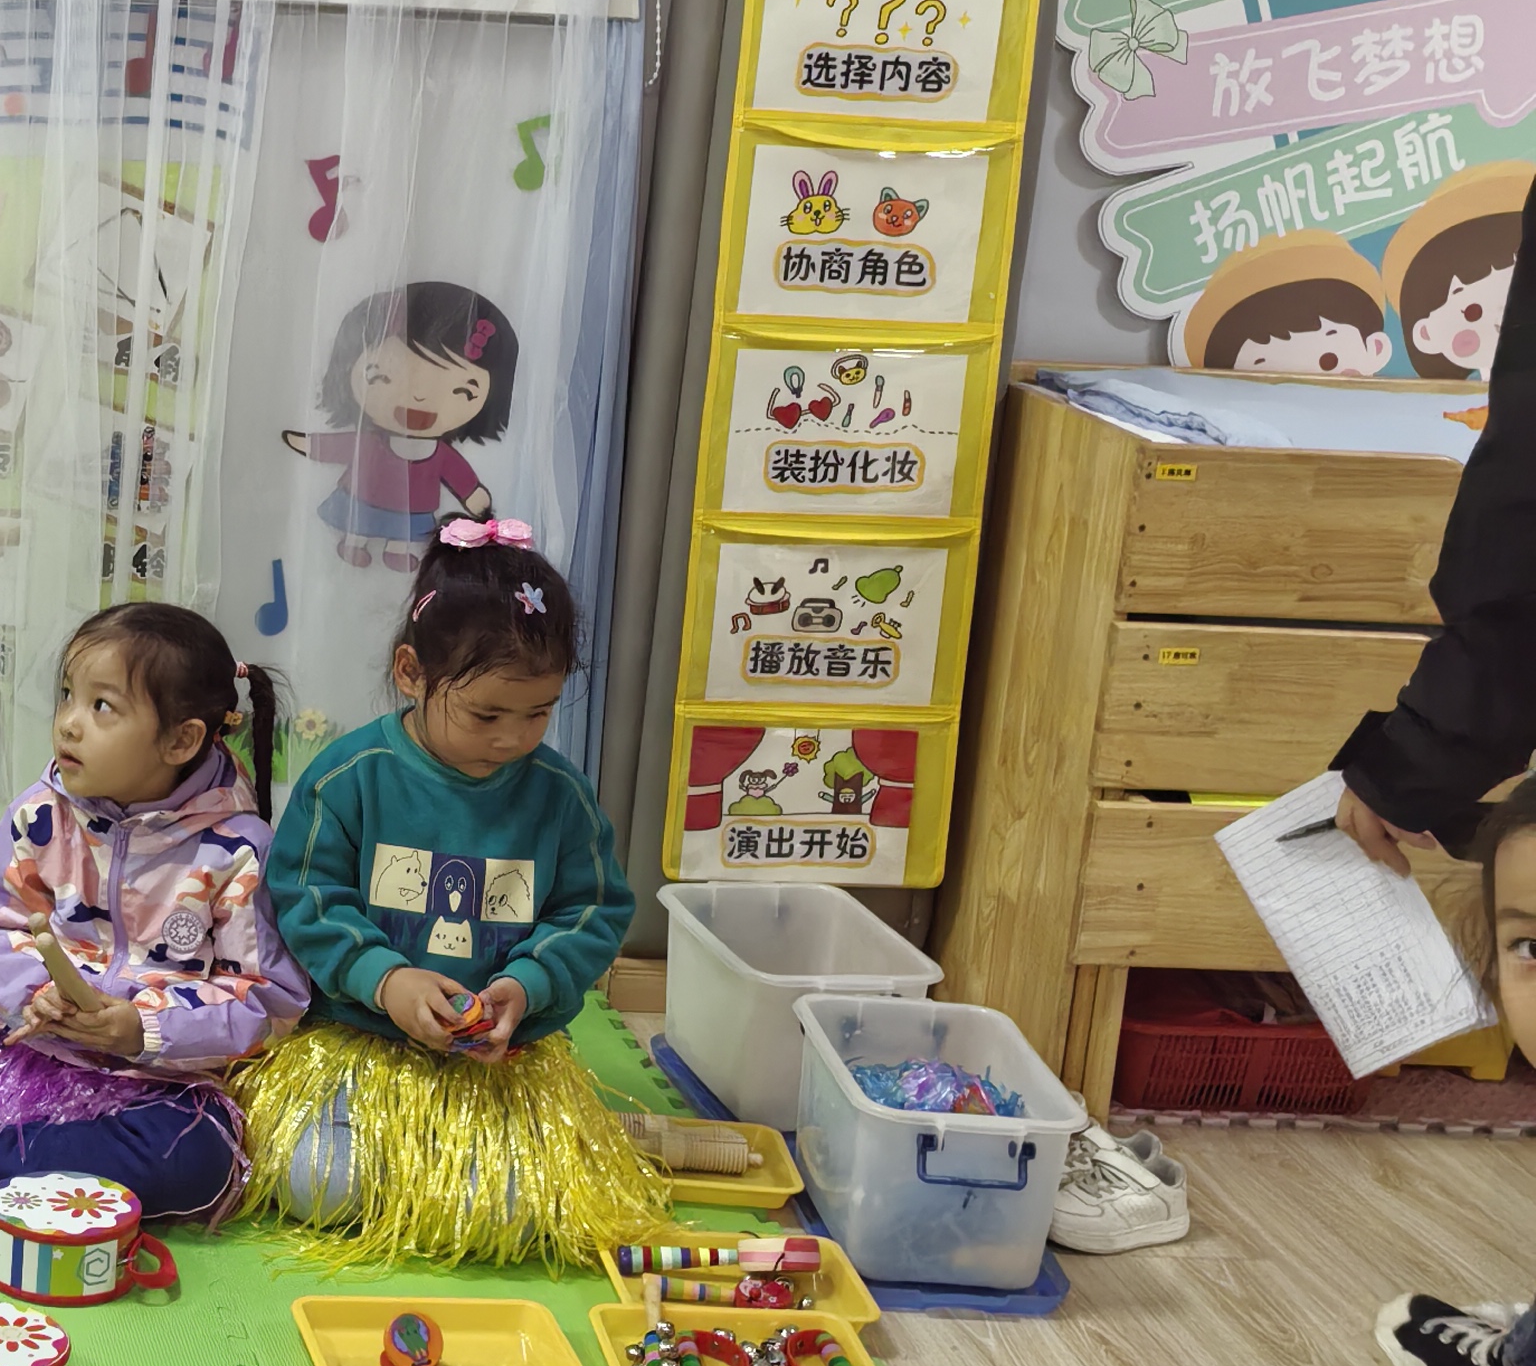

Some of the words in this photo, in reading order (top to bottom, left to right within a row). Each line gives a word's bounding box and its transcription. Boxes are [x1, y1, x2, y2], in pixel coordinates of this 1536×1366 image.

[800, 53, 953, 94] 选择内容
[1209, 13, 1485, 119] 放飞梦想
[1188, 113, 1466, 266] 扬帆起航
[779, 246, 929, 288] 协商角色
[770, 448, 919, 487] 装扮化妆
[748, 642, 894, 680] 播放音乐
[726, 825, 870, 861] 演出开始
